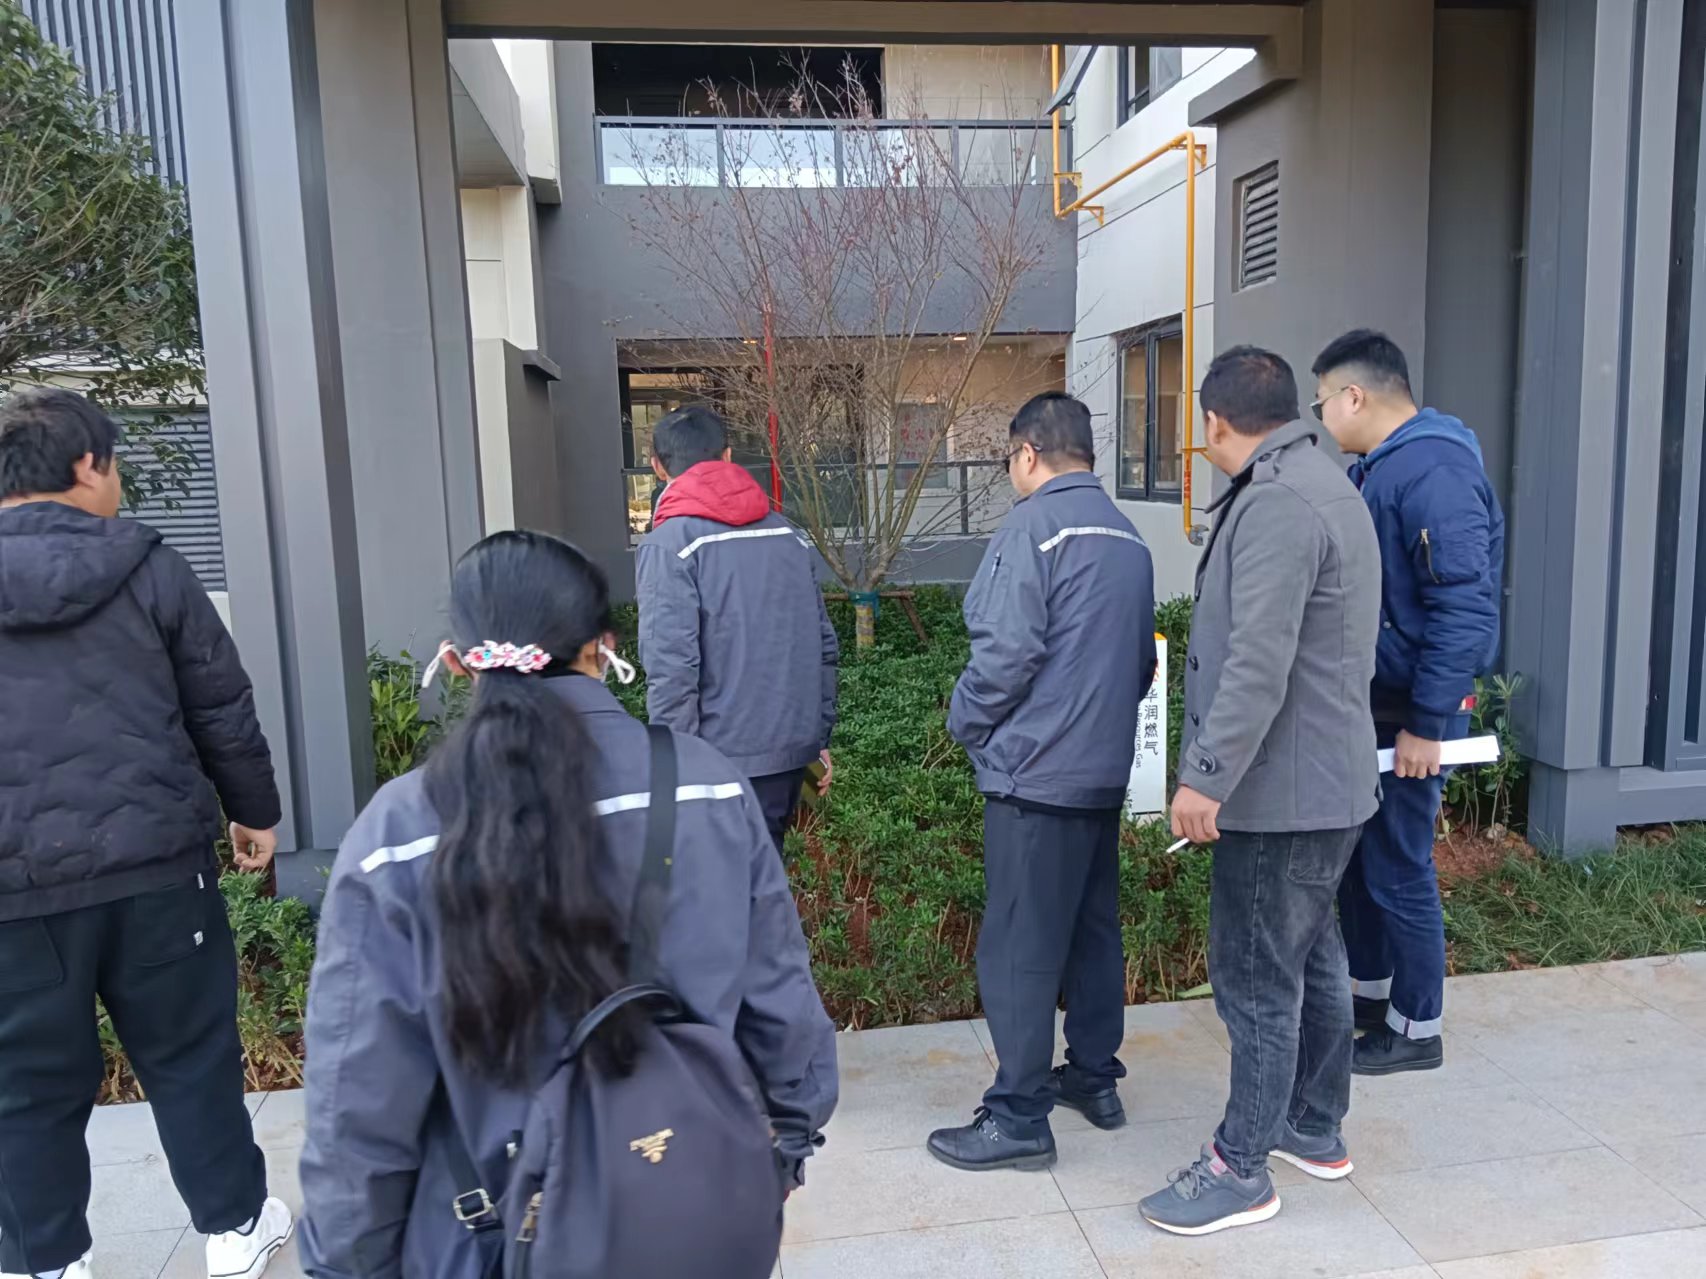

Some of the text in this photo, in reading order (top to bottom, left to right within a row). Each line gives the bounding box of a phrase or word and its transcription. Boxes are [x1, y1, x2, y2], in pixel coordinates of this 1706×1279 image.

[1144, 687, 1158, 756] 华润燃气
[1135, 753, 1143, 769] Gas
